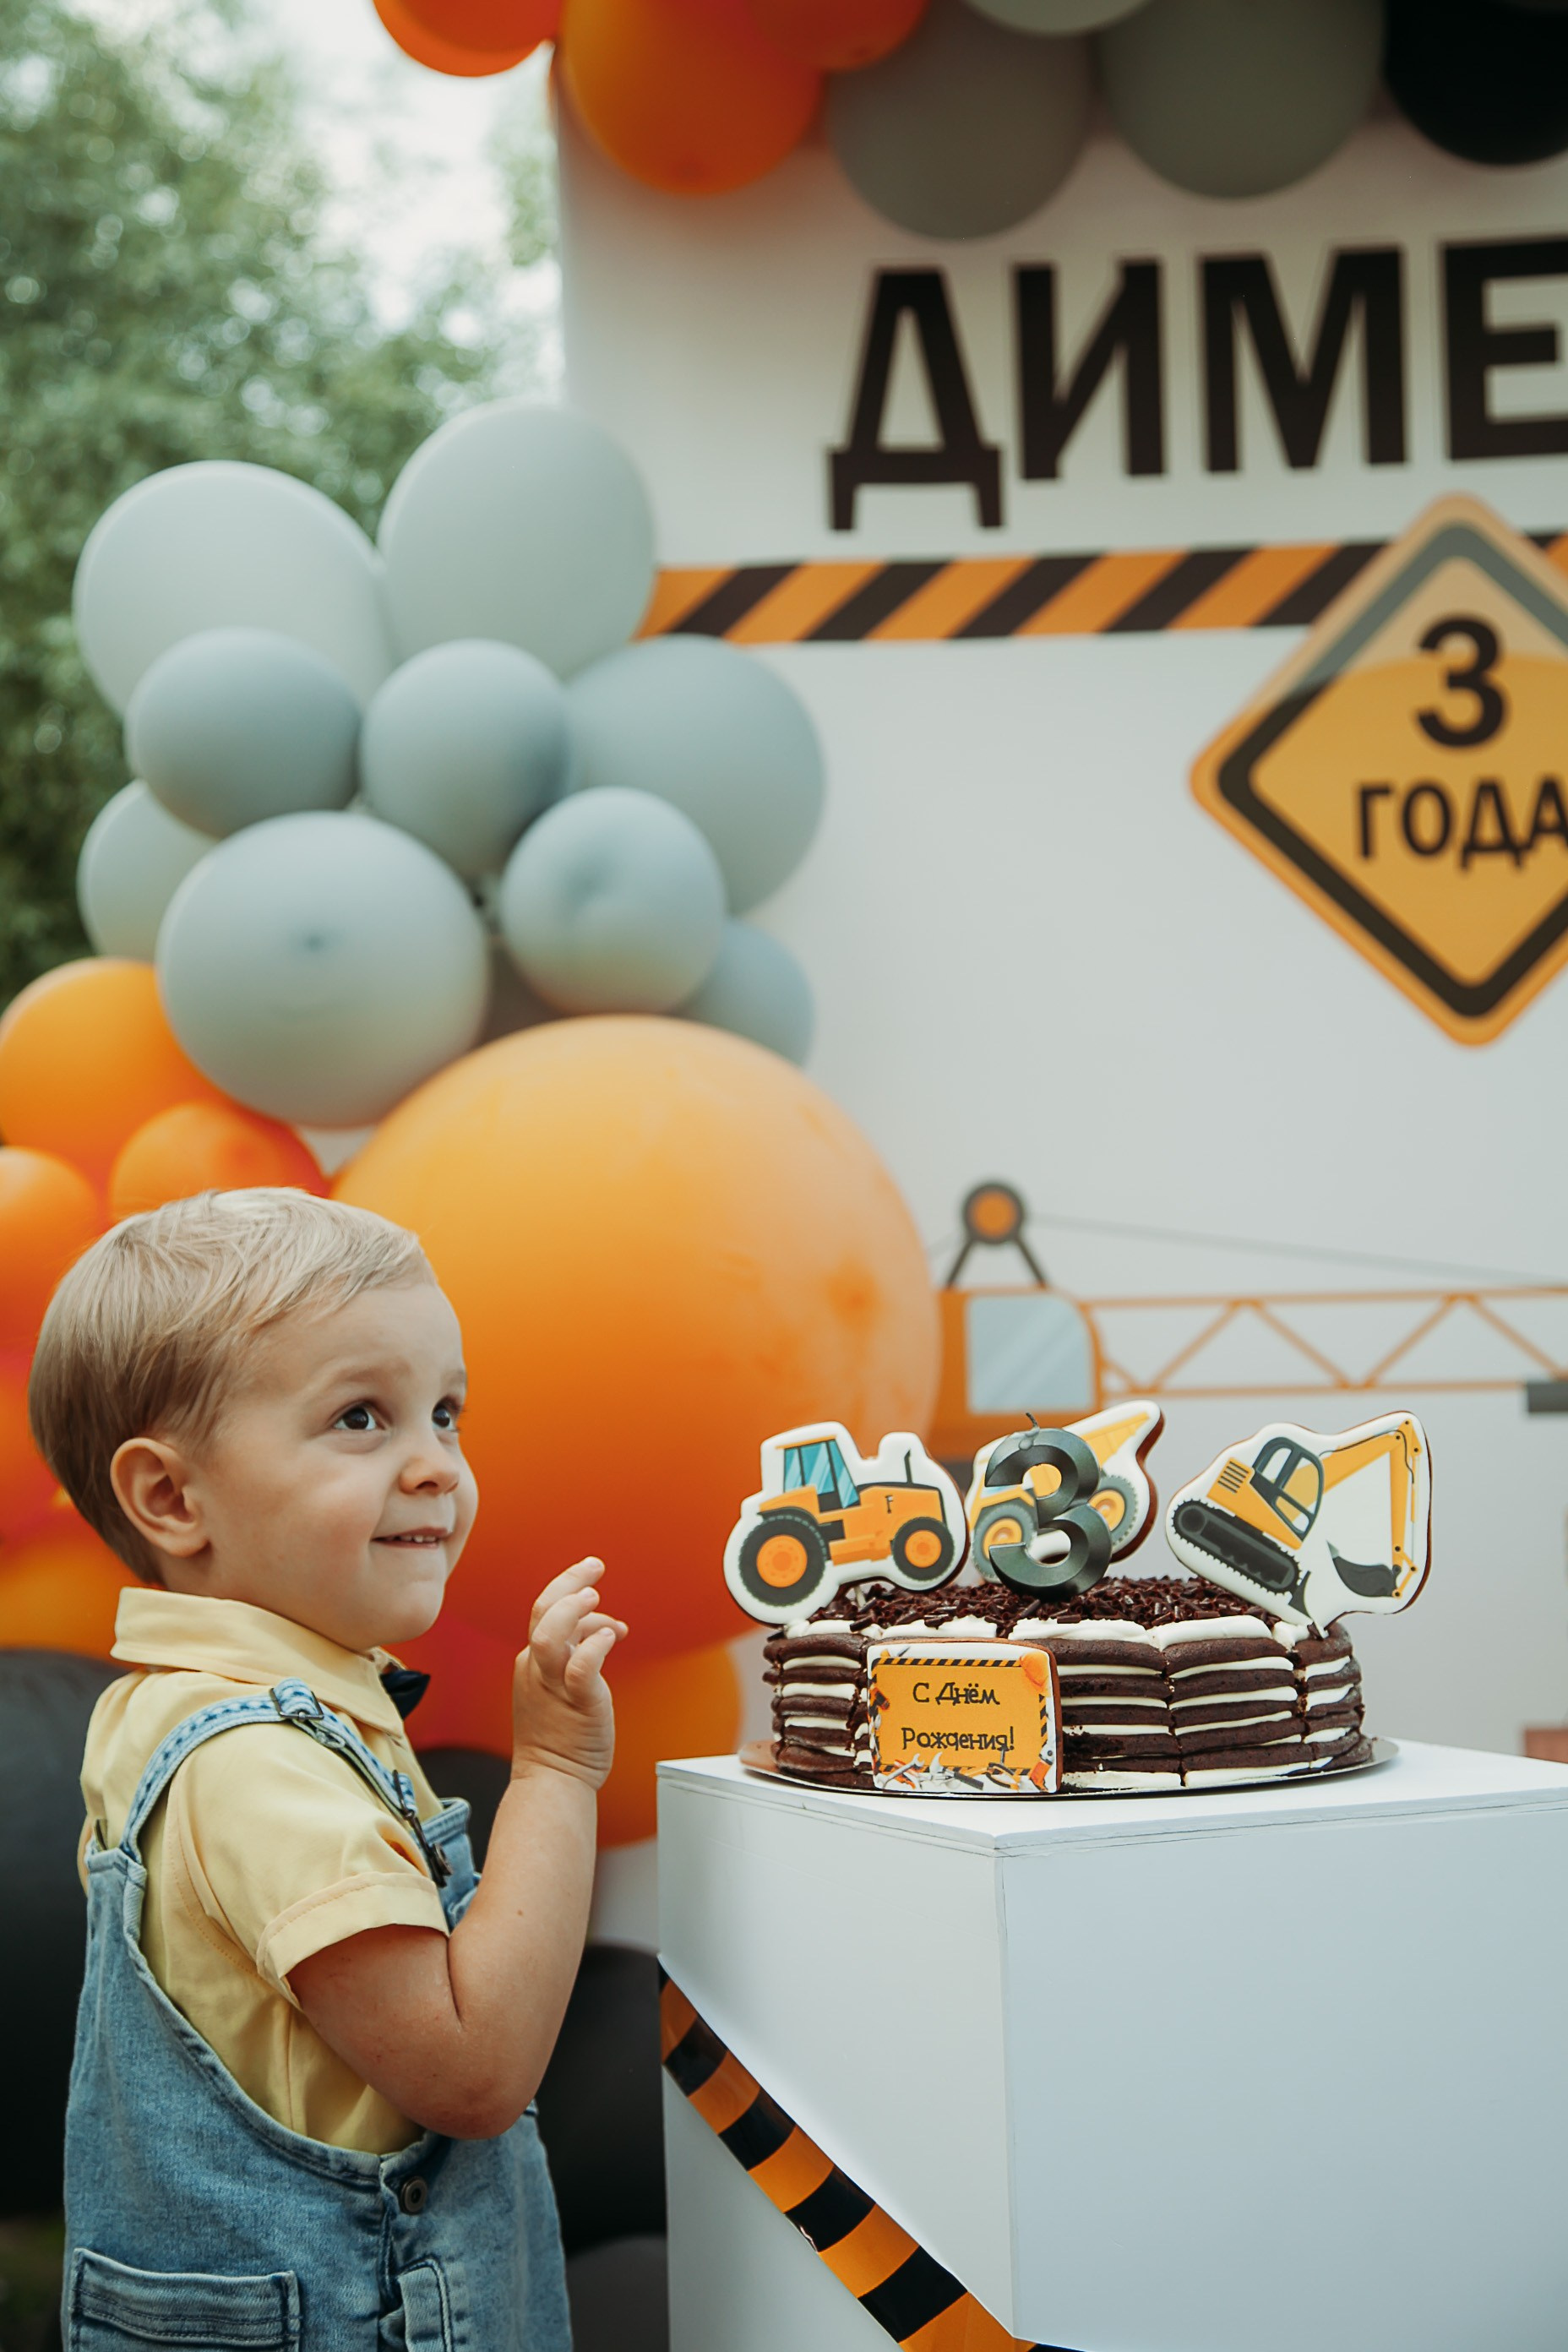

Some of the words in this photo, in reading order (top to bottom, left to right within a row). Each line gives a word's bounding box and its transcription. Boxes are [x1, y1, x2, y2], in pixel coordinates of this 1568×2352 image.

[827, 234, 1568, 530] ДИМЕ
[1415, 613, 1509, 750] 3
[1357, 774, 1568, 872] ГОДА
[984, 1428, 1112, 1603] 3
[901, 1726, 1015, 1751] Рождения!
[912, 1682, 929, 1703] С
[934, 1681, 1000, 1707] Днём
